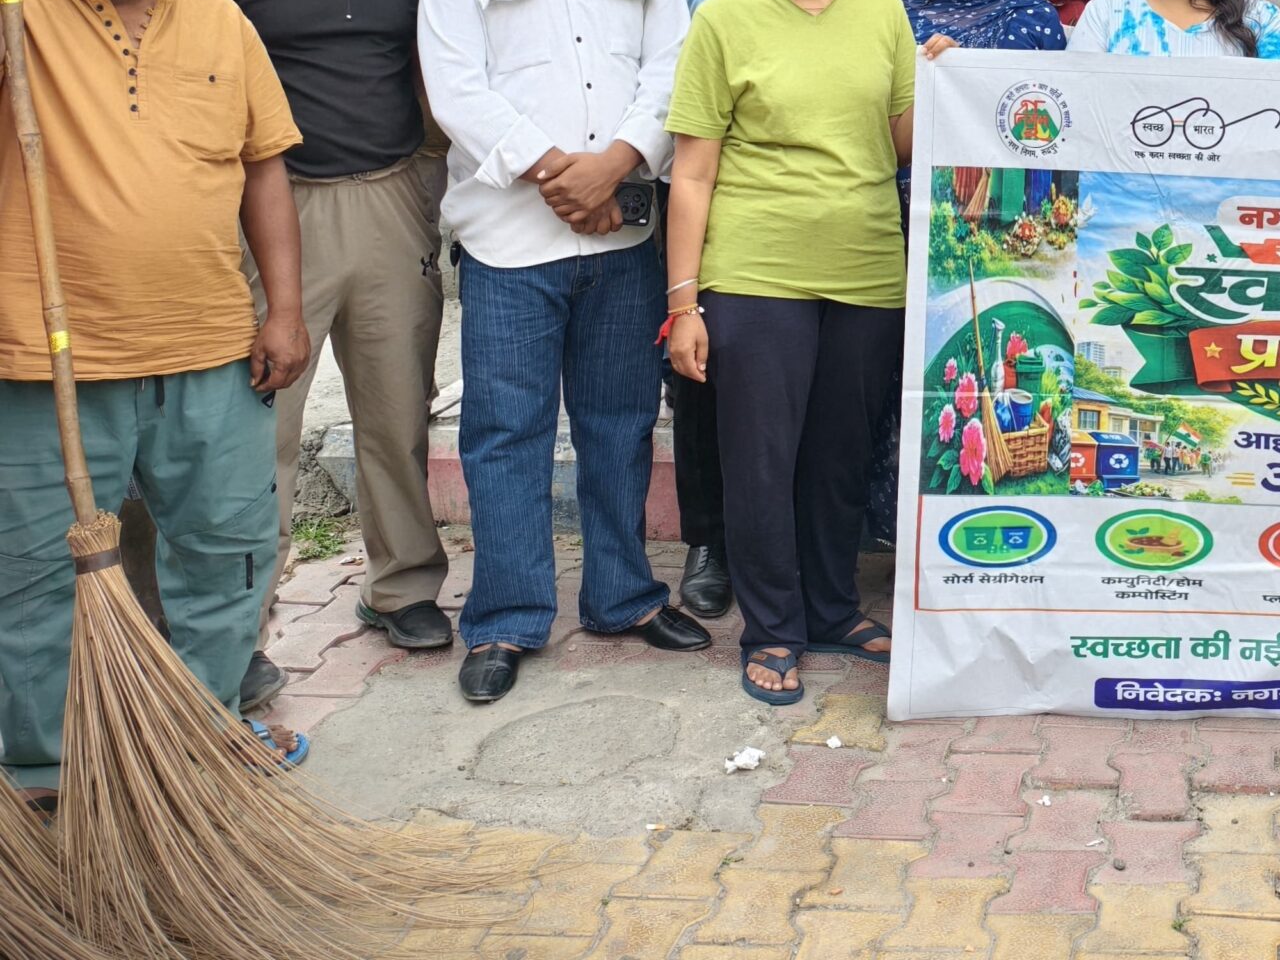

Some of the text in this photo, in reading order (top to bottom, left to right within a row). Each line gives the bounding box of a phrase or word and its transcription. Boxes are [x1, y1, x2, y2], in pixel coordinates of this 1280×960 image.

[1142, 122, 1215, 135] स्वच्छ भारत
[942, 573, 974, 584] सोर्स
[1070, 636, 1182, 660] स्वच्छता
[1189, 630, 1231, 660] की
